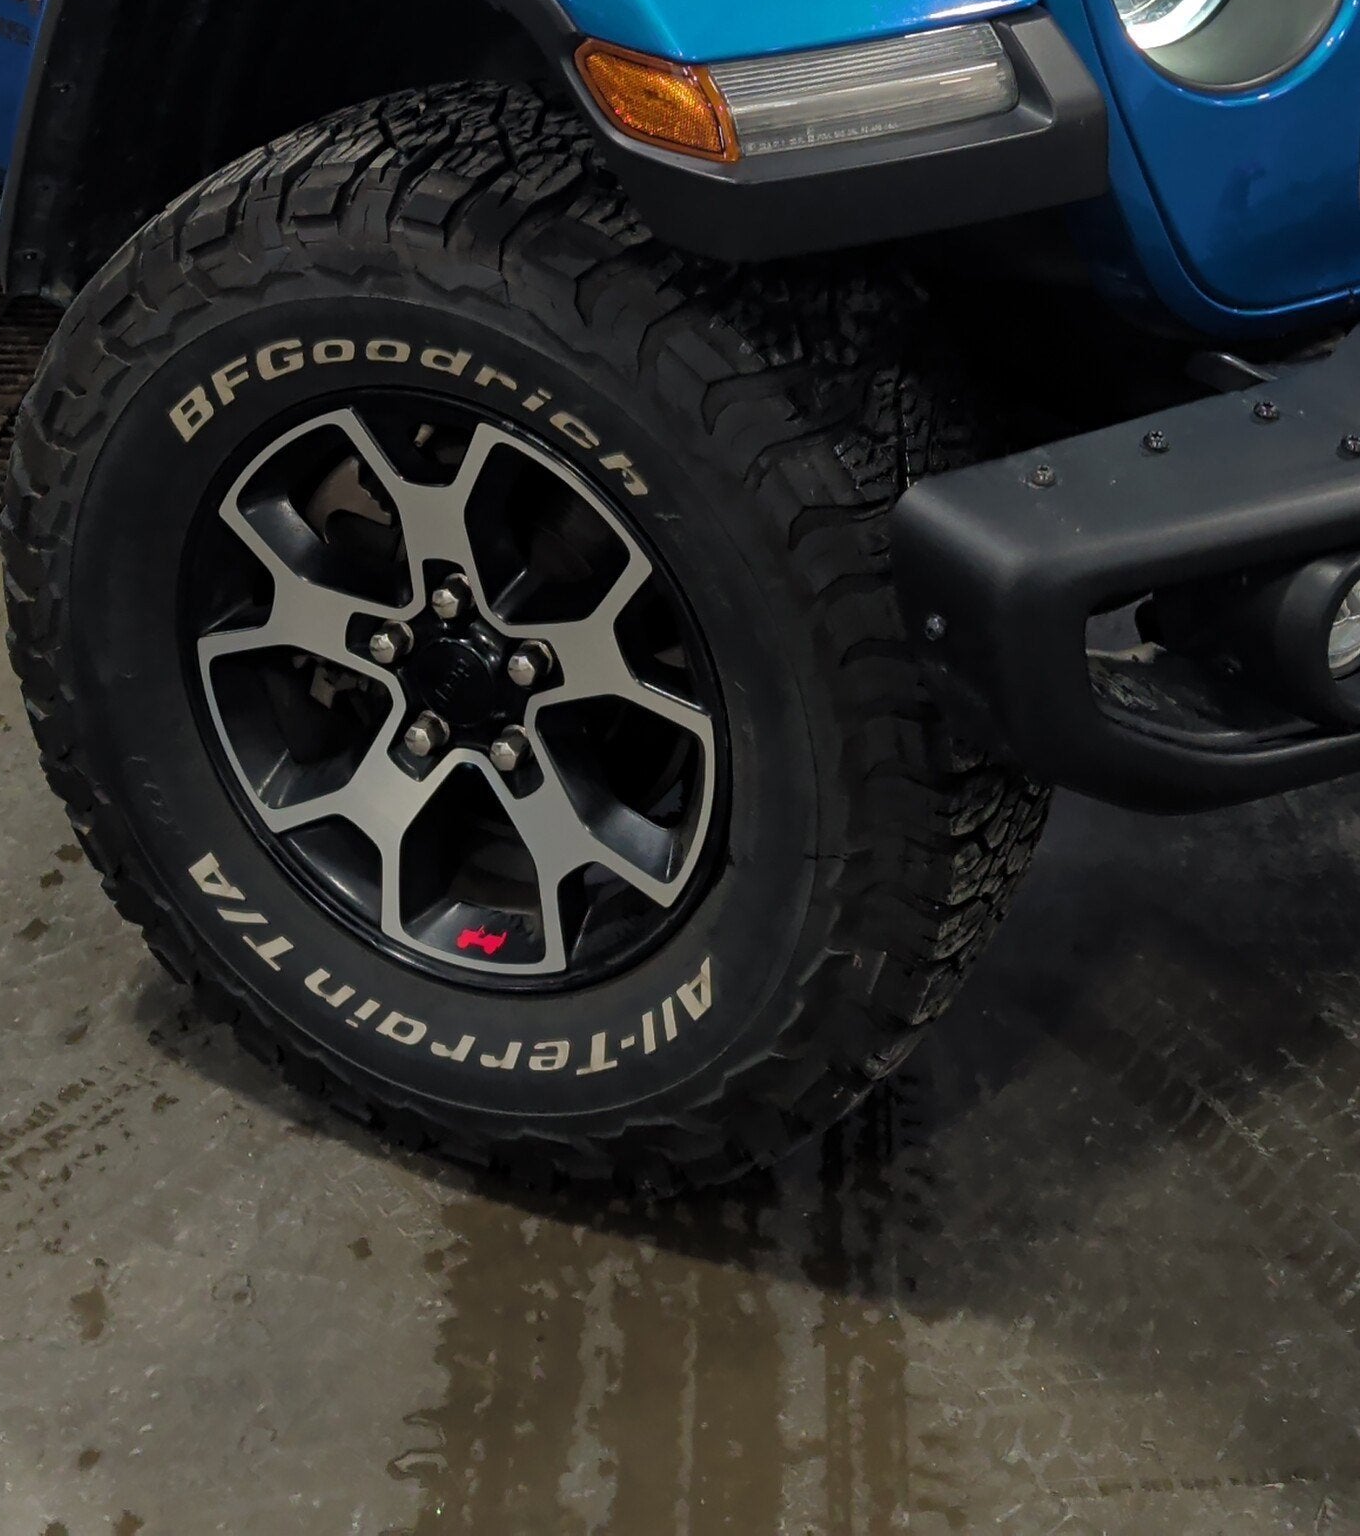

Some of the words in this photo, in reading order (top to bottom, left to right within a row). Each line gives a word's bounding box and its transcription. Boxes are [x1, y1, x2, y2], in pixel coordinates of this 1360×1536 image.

[167, 337, 649, 497] BFGoodrich
[187, 851, 295, 972] T/A
[303, 956, 715, 1076] All-Terrain
